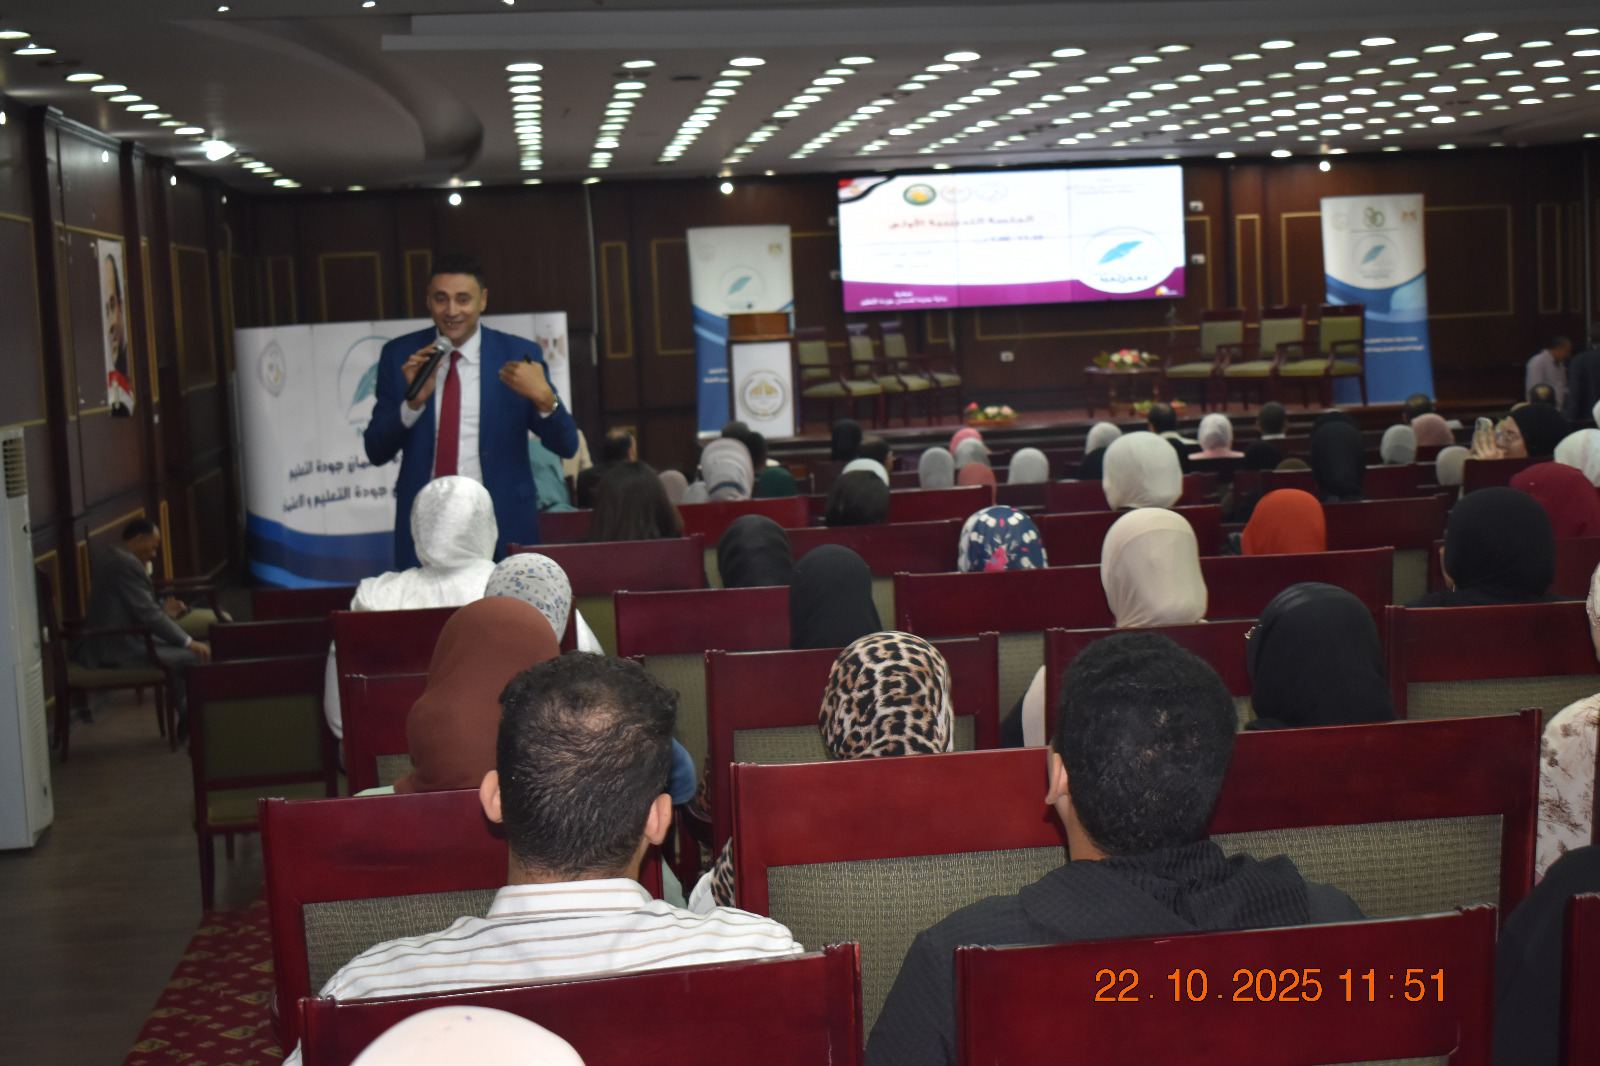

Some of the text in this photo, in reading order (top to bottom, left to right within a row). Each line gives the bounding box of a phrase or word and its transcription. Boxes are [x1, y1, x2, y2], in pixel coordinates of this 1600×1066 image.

[316, 459, 344, 475] جودة
[314, 486, 351, 507] التعليم
[355, 485, 388, 500] جودة
